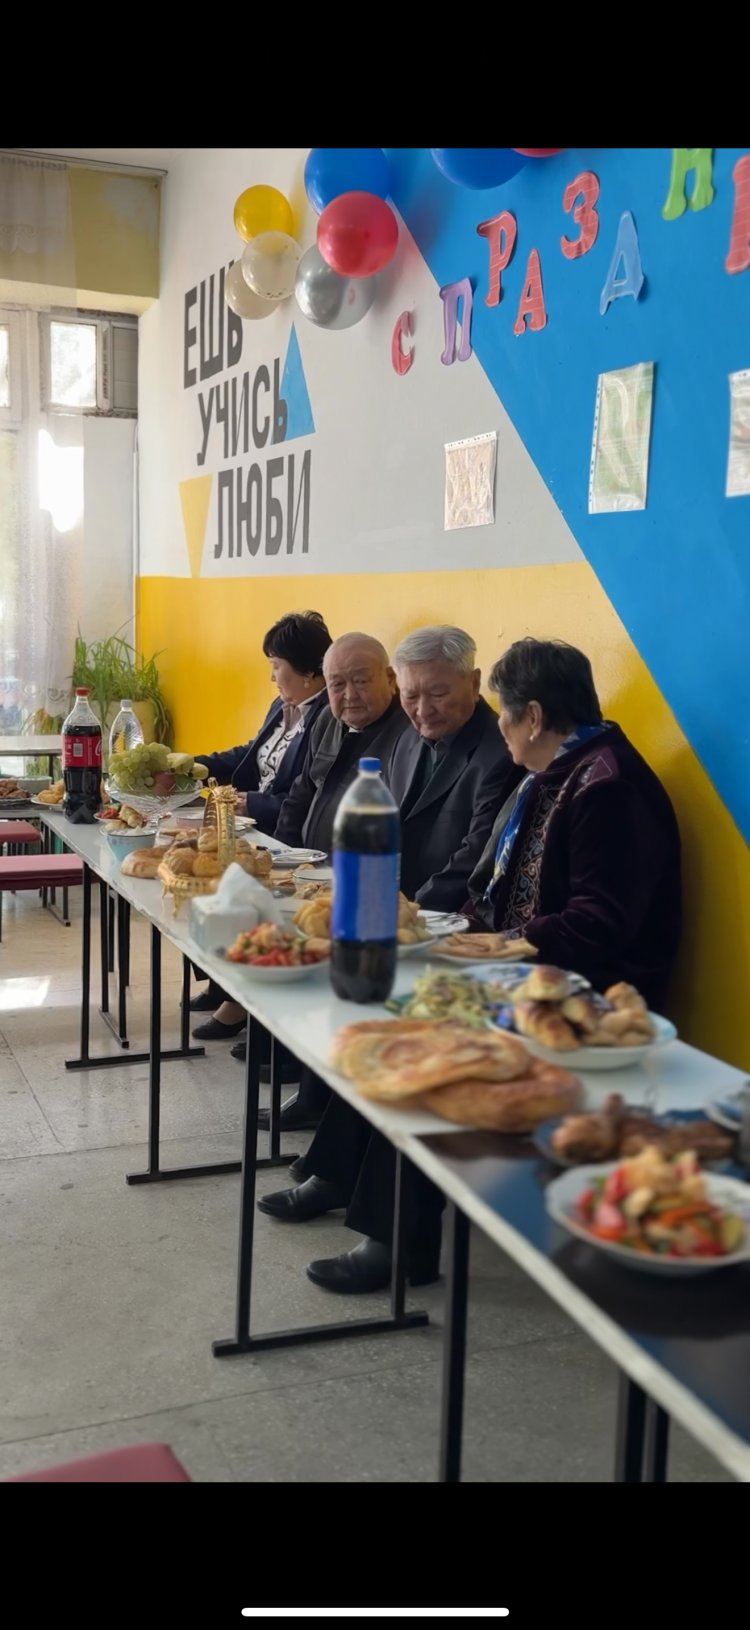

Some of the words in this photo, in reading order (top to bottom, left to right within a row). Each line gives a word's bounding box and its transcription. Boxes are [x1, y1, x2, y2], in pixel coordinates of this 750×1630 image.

[439, 148, 750, 366] ПРАЗДН
[183, 259, 243, 390] ЕШЬ
[197, 357, 289, 467] УЧИСЬ
[213, 449, 312, 560] ЛЮБИ
